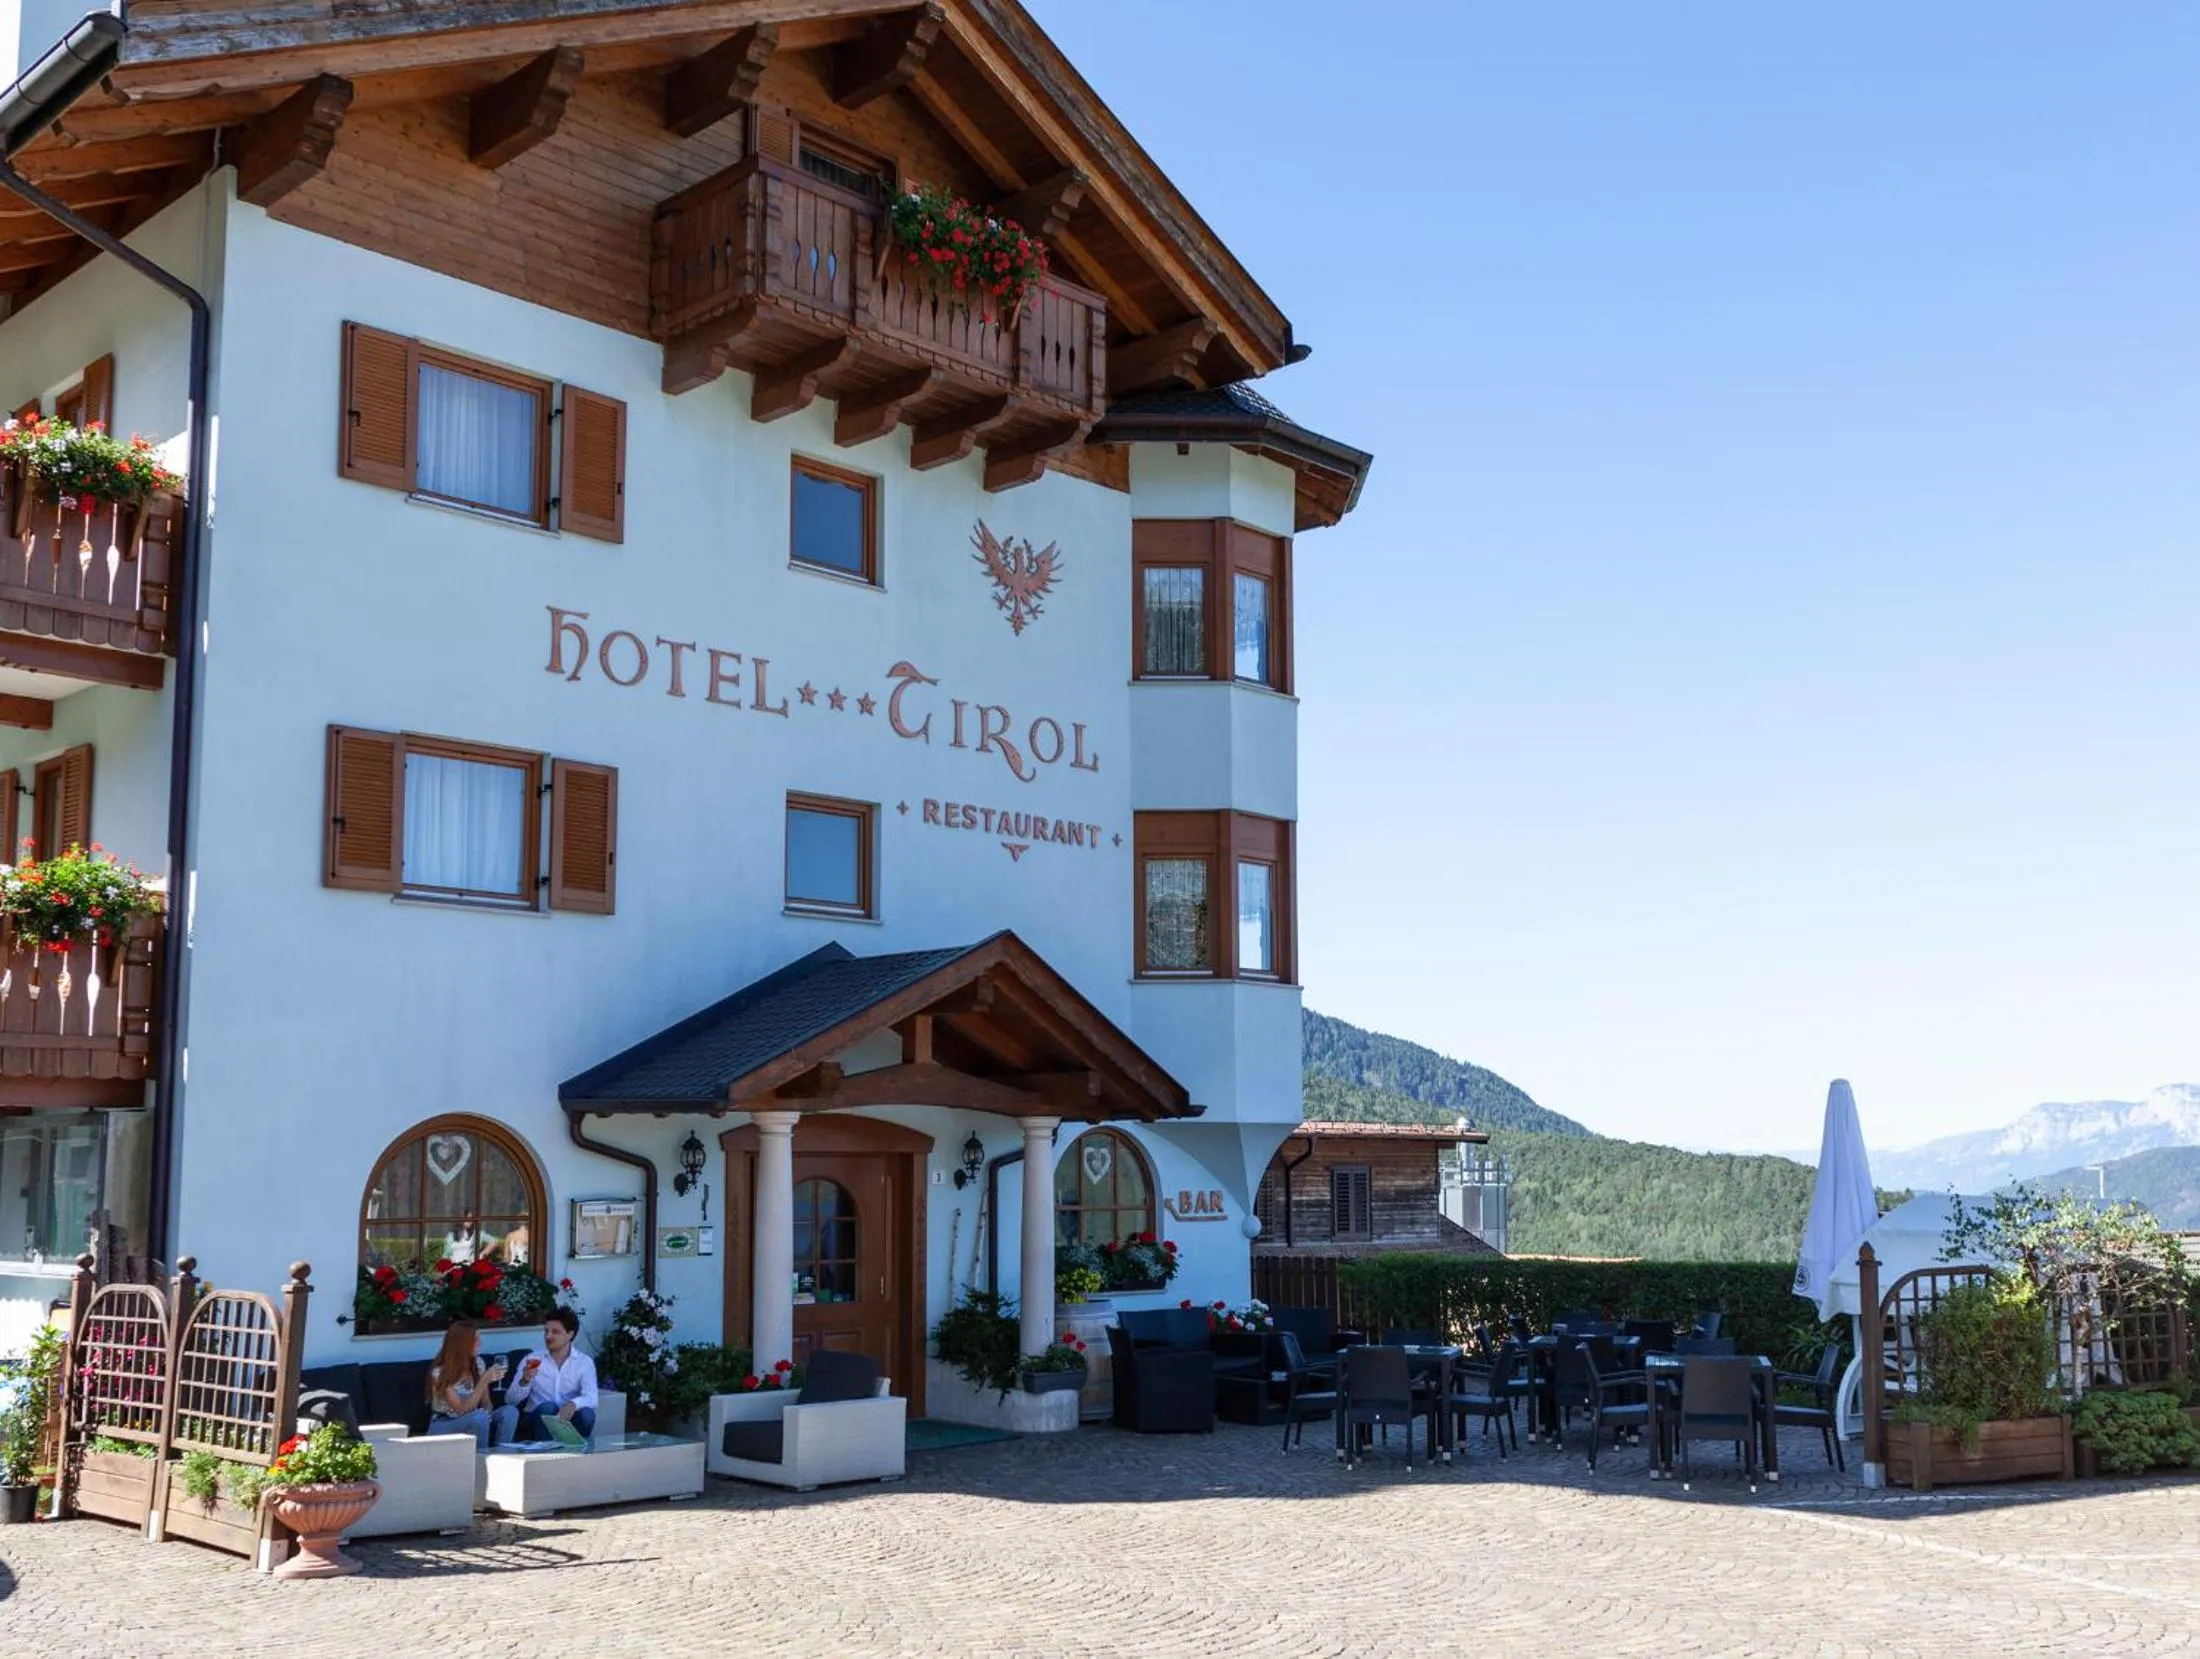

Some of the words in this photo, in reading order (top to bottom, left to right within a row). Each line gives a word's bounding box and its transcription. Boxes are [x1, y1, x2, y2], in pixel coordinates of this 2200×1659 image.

[545, 605, 789, 718] HOTEL
[886, 660, 1099, 782] TIROL
[923, 798, 1102, 848] RESTAURANT
[1179, 1190, 1224, 1214] BAR
